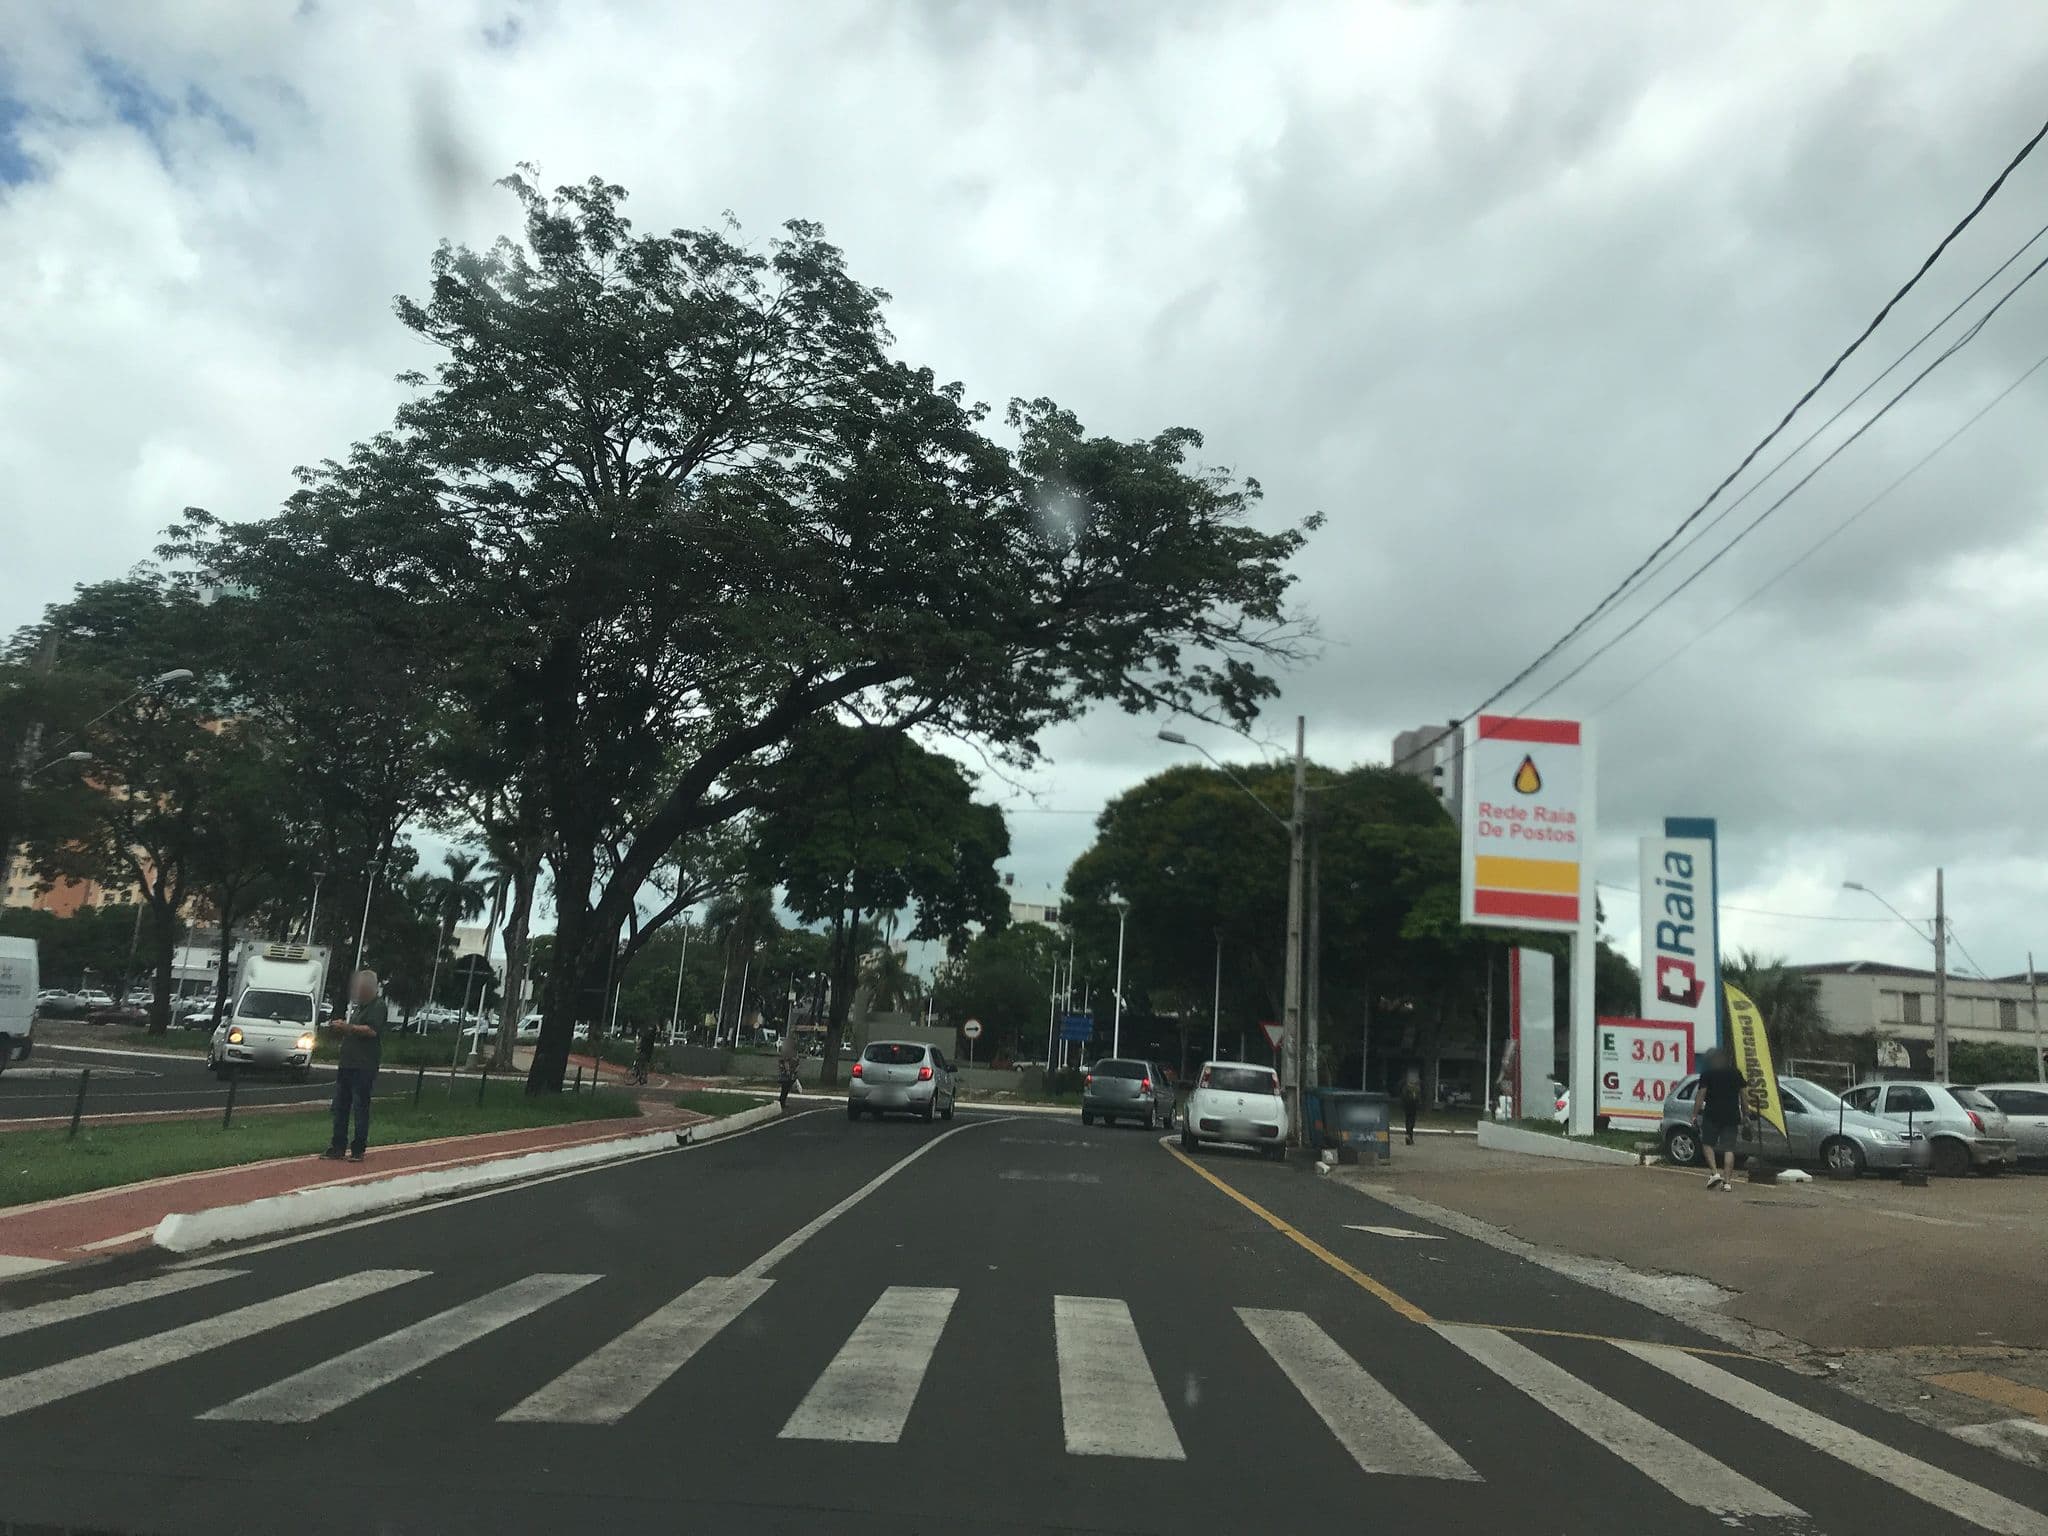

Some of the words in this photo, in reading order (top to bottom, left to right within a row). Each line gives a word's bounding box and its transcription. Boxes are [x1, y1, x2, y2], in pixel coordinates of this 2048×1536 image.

[1479, 802, 1527, 820] Rede
[1534, 806, 1576, 824] Raia
[1479, 820, 1503, 837] De
[1510, 823, 1576, 843] Postos
[1656, 851, 1695, 956] Raia
[1603, 1033, 1615, 1050] E
[1631, 1039, 1679, 1062] 3,01
[1738, 1015, 1770, 1110] CHURRASCO
[1603, 1072, 1619, 1089] G
